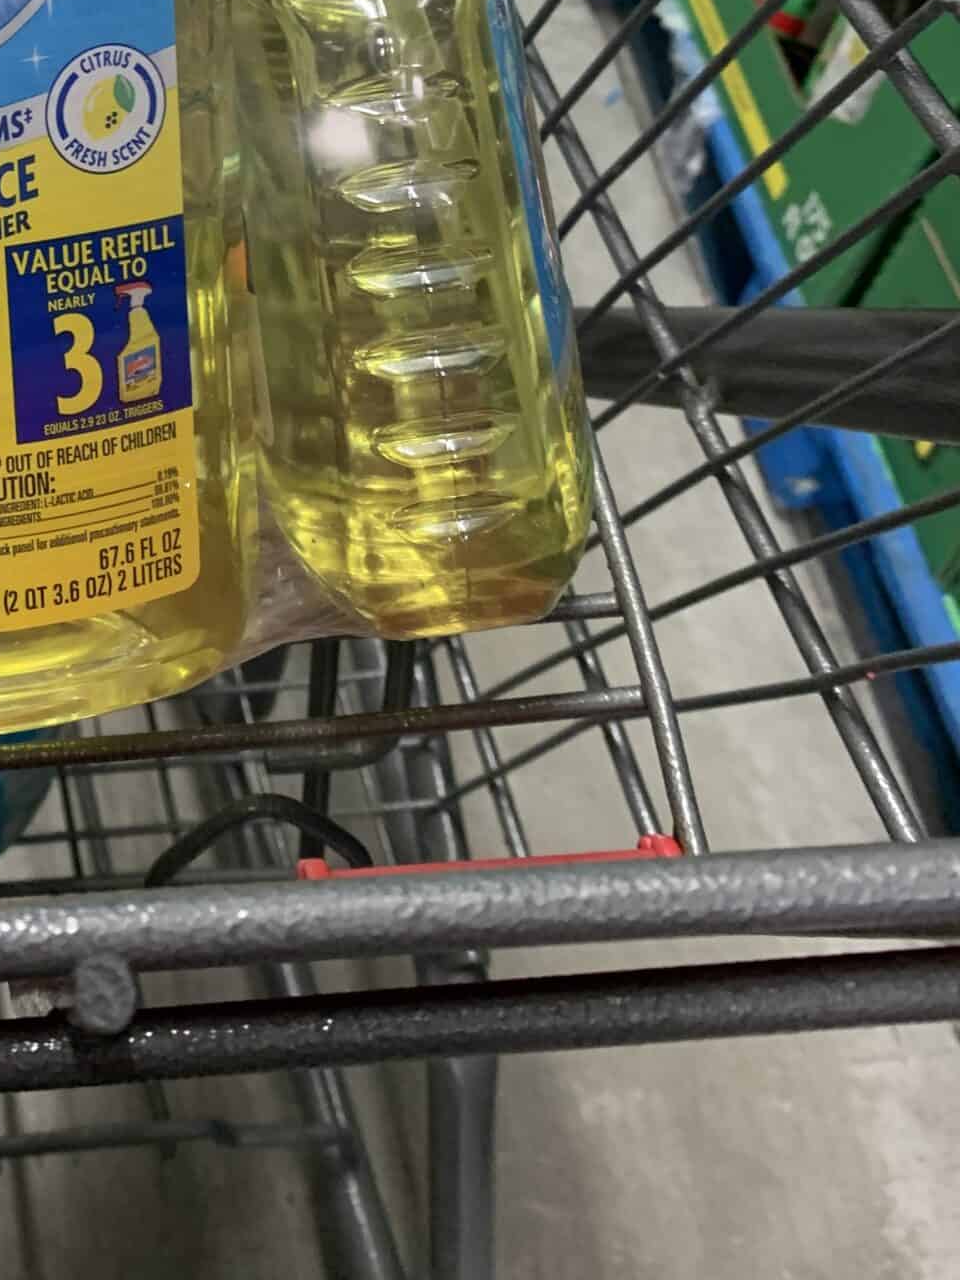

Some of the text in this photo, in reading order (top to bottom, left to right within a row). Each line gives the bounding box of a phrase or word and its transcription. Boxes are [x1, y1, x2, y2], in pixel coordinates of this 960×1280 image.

[80, 49, 132, 74] CITRUS
[64, 126, 152, 167] FRESH SCENT
[11, 224, 175, 276] VALUE REFILL
[46, 256, 147, 294] EQUAL TO
[47, 293, 96, 313] NEARLY
[52, 312, 104, 416] 3
[6, 453, 32, 474] OUT
[37, 450, 54, 469] OF
[57, 441, 98, 466] REACH
[102, 437, 119, 456] OF
[121, 421, 177, 452] CHILDREN
[44, 418, 78, 436] EQUALS
[99, 528, 182, 570] 67.6 FL OZ
[3, 553, 182, 616] (2 QT 3.6 OZ) 2 LITERS
